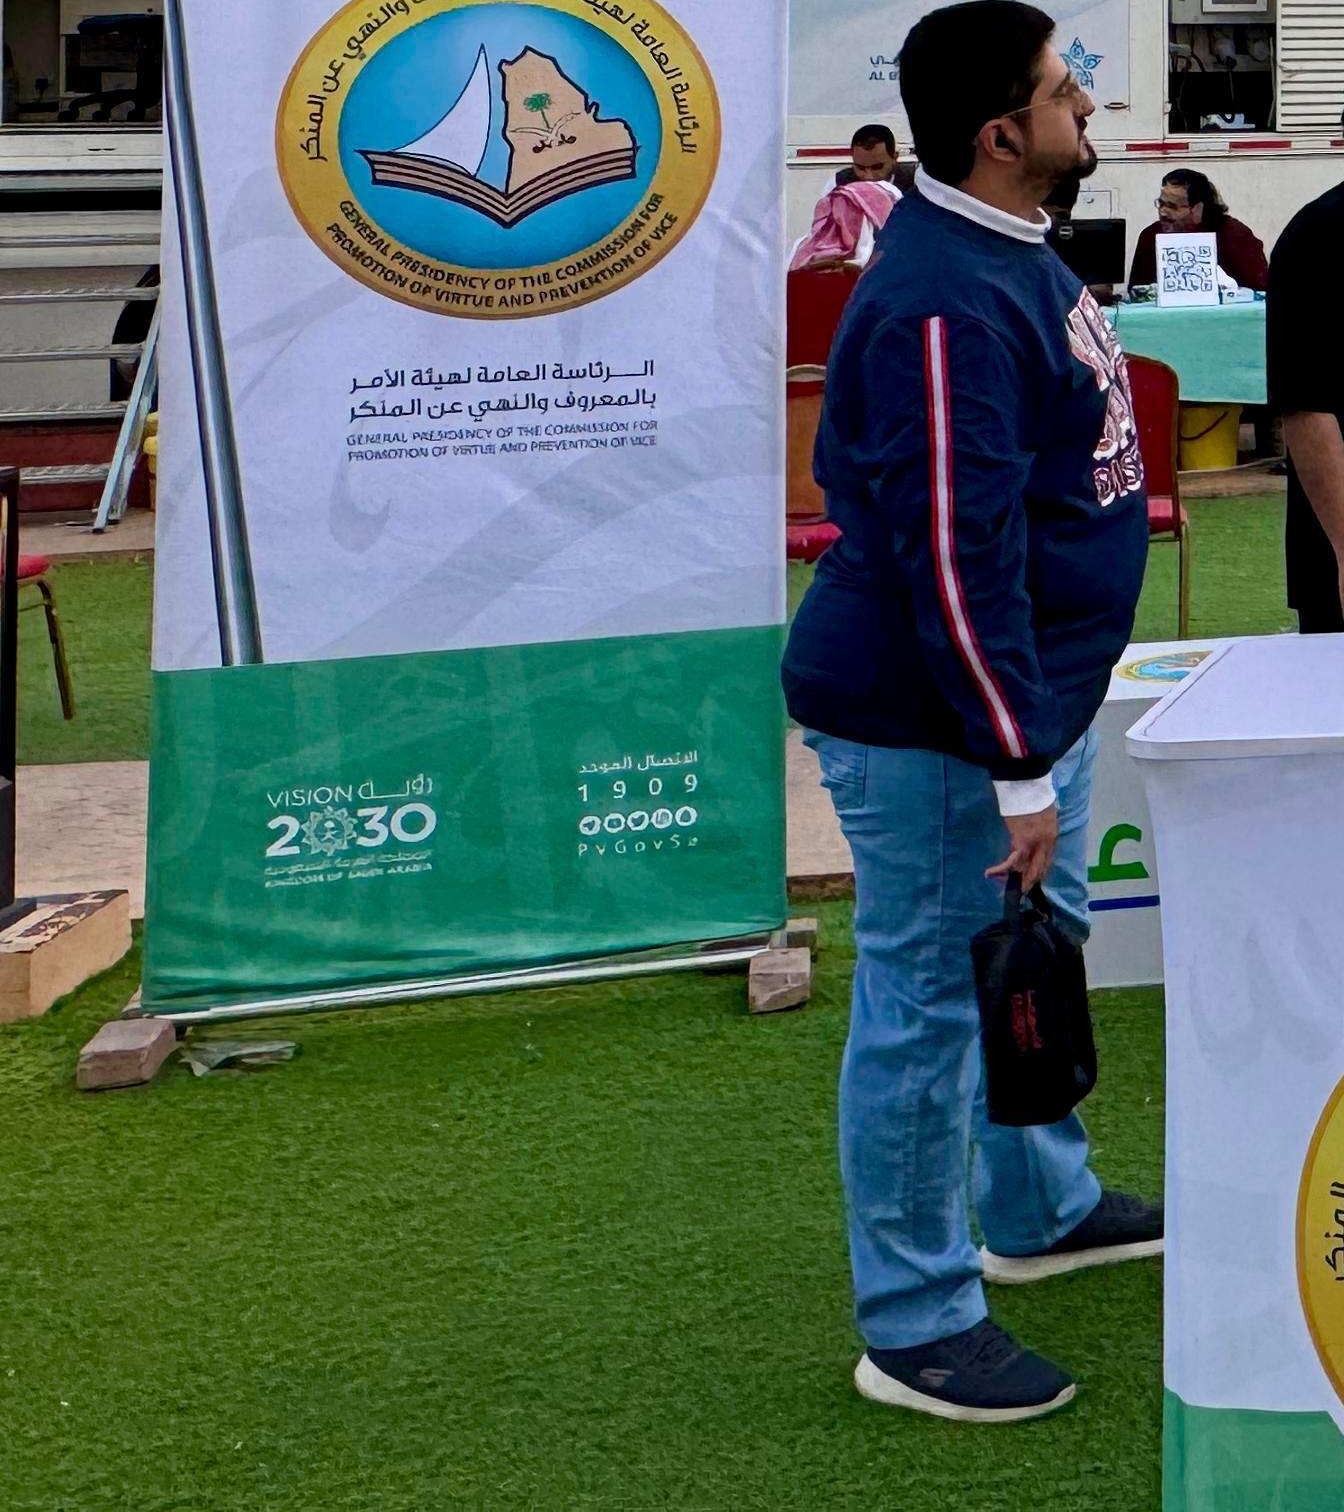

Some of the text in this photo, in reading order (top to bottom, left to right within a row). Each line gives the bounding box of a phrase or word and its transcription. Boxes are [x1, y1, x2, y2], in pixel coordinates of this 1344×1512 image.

[349, 359, 655, 395] الرئاسة العامة لهيئة الأمر
[349, 387, 657, 424] بالمعروف والنهي عن المنكر
[266, 785, 353, 809] VISION
